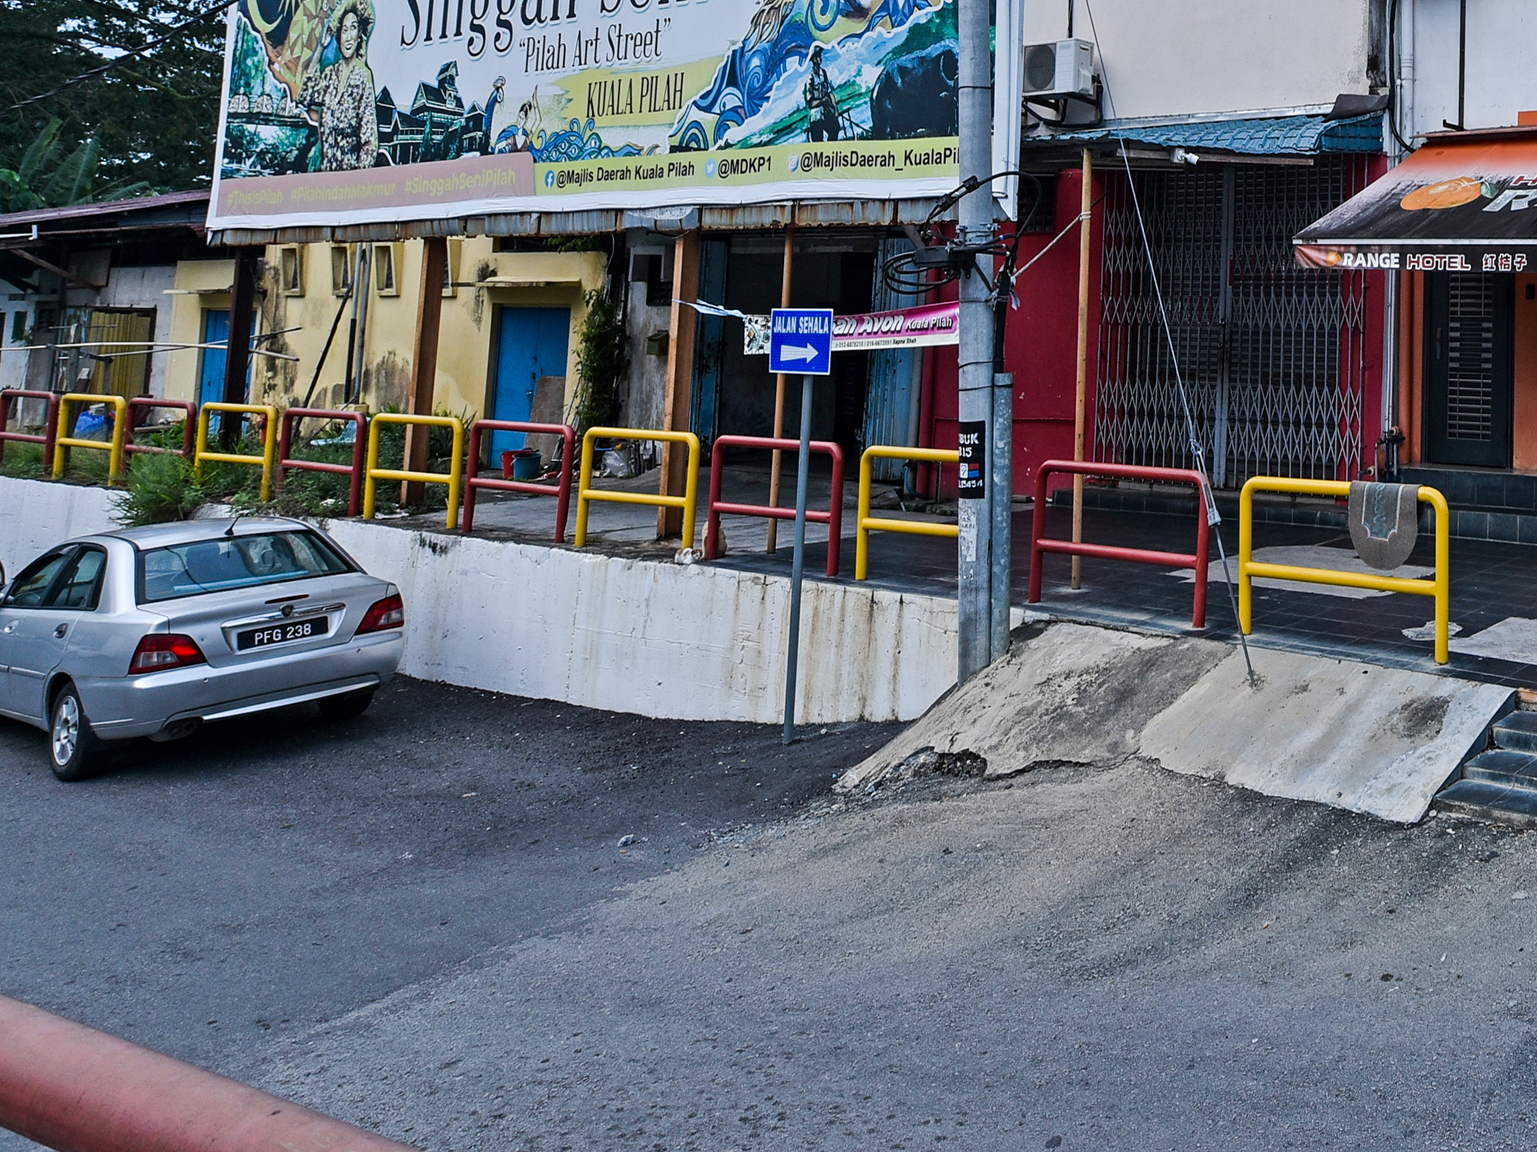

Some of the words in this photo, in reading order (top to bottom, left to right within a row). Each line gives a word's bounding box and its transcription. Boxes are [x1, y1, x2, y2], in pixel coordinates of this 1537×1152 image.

[574, 27, 601, 68] Art
[586, 77, 634, 119] KUALA
[638, 71, 686, 113] PILAH
[717, 157, 772, 178] @MDKP1
[800, 146, 959, 173] @MajlisDaerah_KualaPil
[404, 166, 517, 198] #SinggahSeniPilah
[556, 167, 594, 189] @Majlis
[596, 165, 632, 184] Daerah
[634, 164, 665, 181] Kuala
[667, 161, 695, 179] Pilah
[1406, 253, 1472, 271] HOTEL
[773, 316, 797, 334] JALAN
[799, 316, 829, 334] SEHALA
[858, 314, 905, 334] Avon
[930, 316, 953, 328] Pilah
[254, 629, 282, 646] PFG
[286, 623, 312, 639] 238
